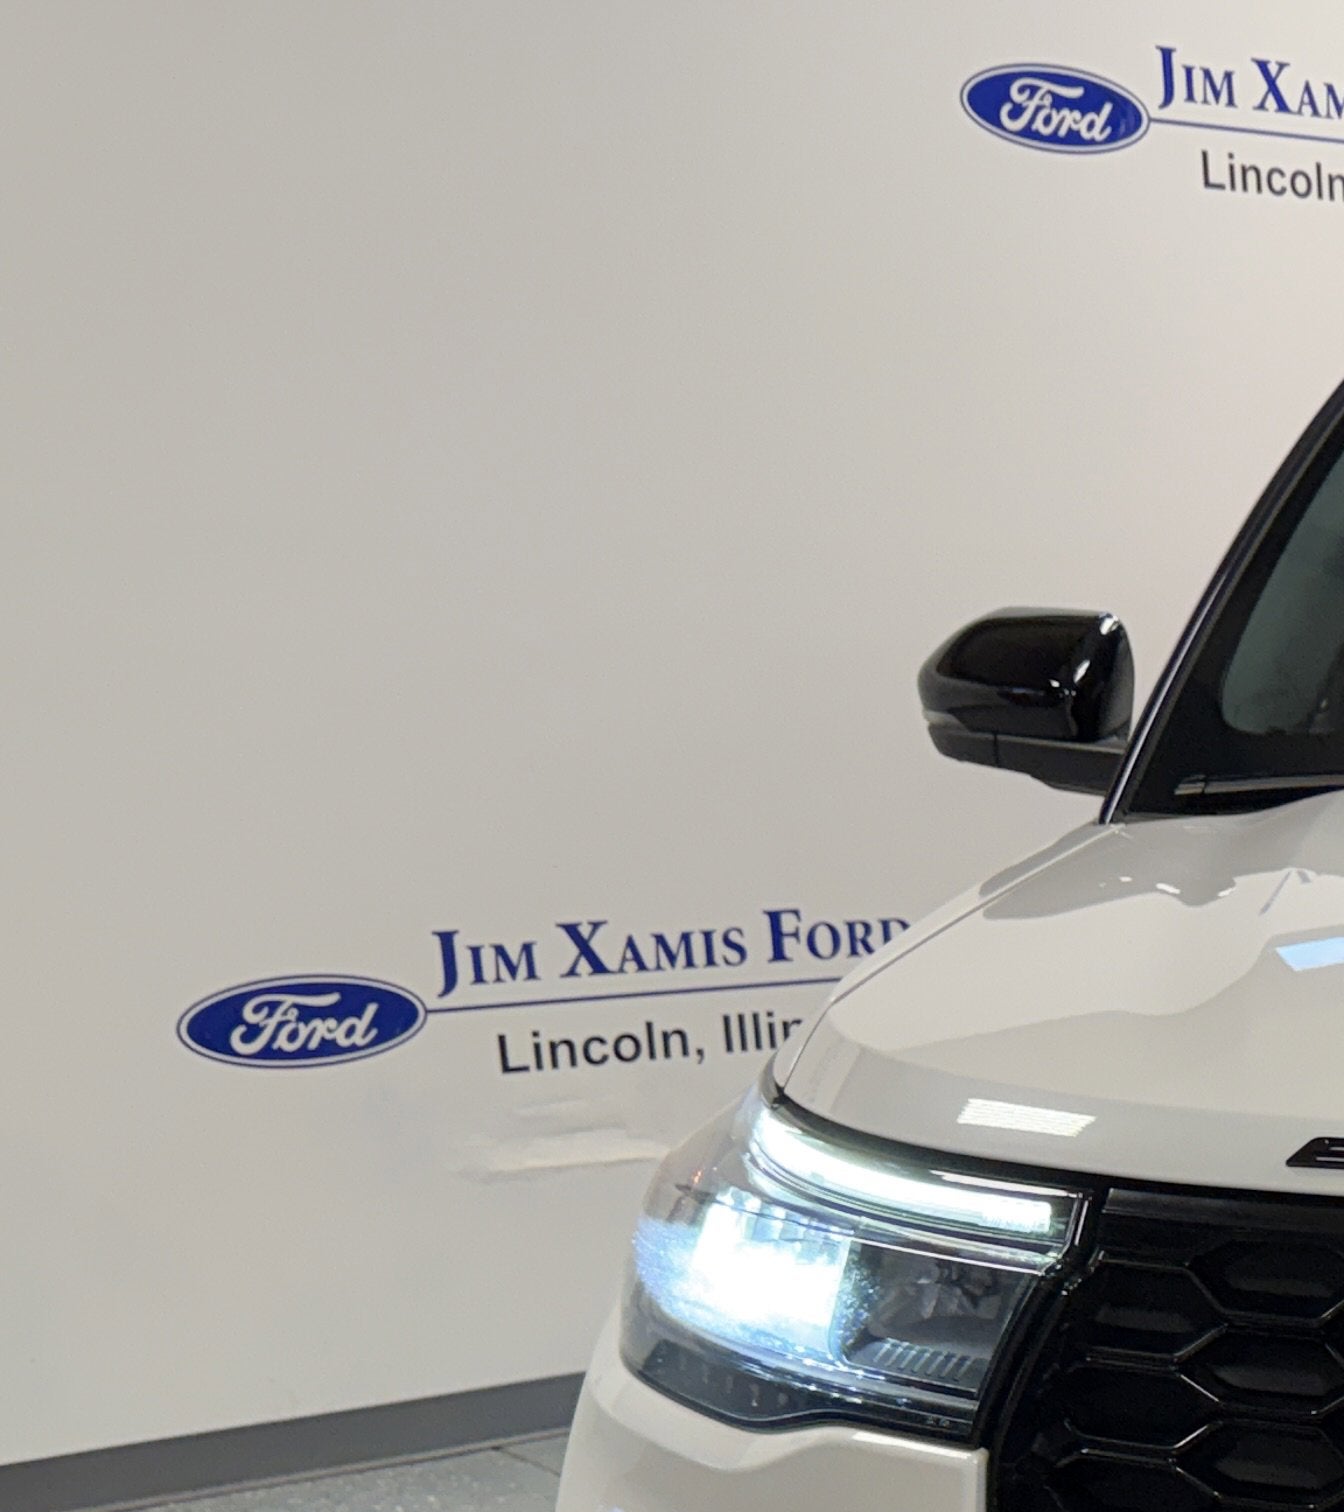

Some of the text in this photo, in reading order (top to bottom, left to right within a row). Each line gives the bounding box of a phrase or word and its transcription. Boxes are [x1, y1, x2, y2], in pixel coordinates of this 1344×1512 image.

[1001, 76, 1114, 142] Ford
[555, 919, 749, 979] XAMIS
[229, 993, 377, 1054] Ford
[497, 1018, 704, 1076] Lincoln,
